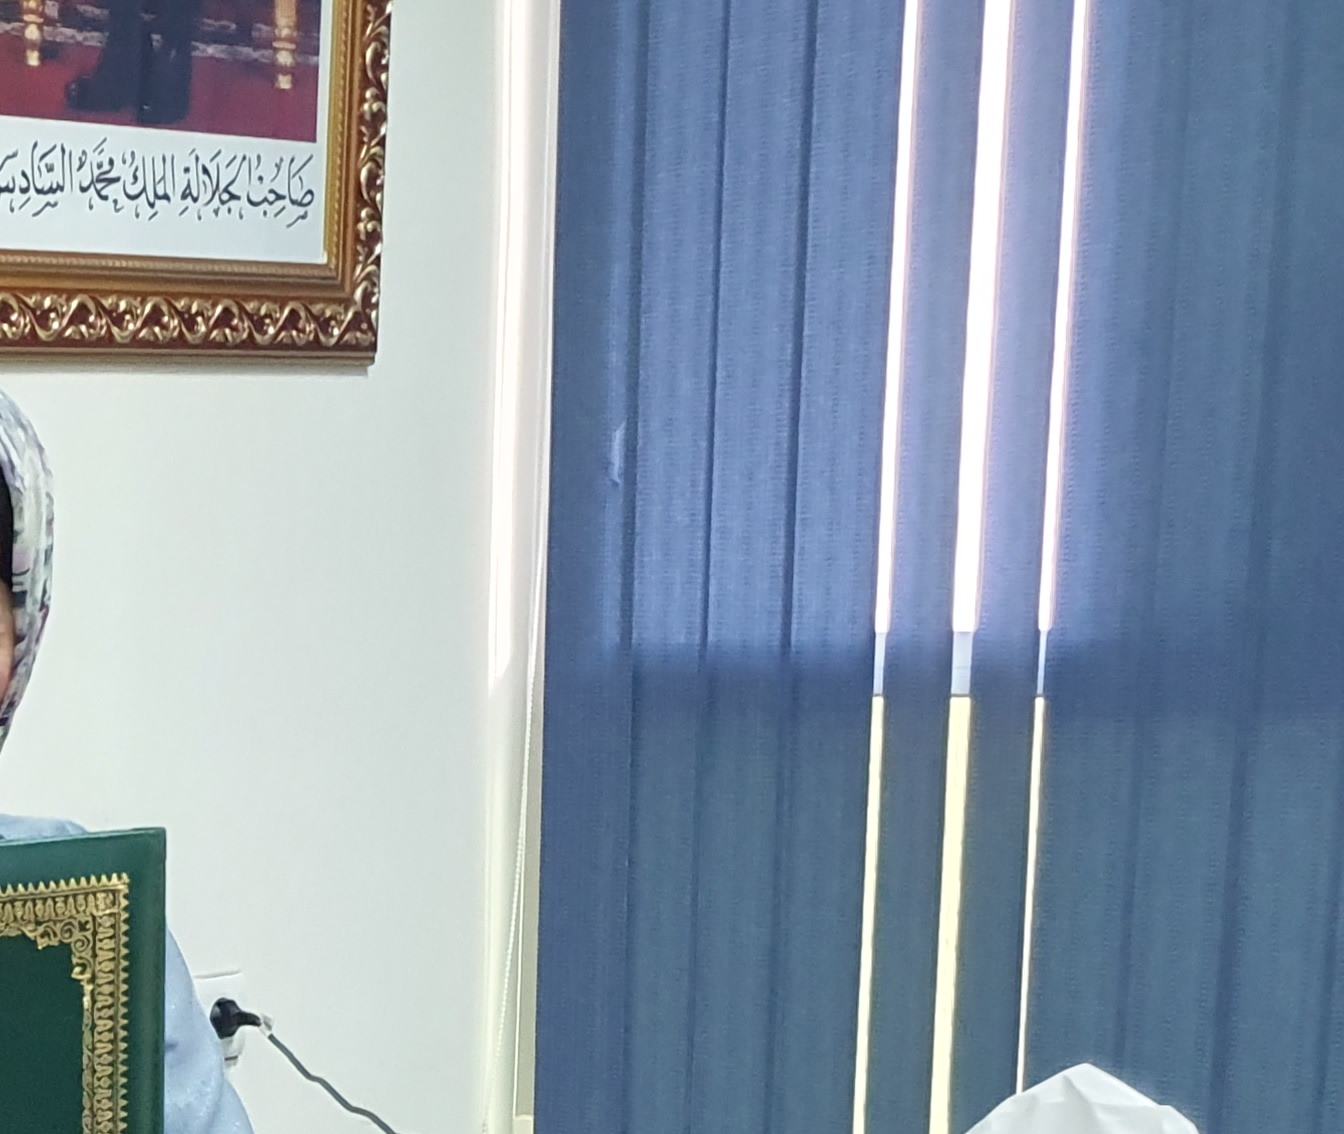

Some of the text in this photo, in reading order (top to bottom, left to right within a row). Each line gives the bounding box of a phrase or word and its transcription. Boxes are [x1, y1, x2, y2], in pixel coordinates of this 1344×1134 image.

[76, 138, 122, 212] محمد
[122, 151, 176, 221] الملك
[179, 149, 252, 220] الجلالة
[246, 154, 315, 228] صاحب
